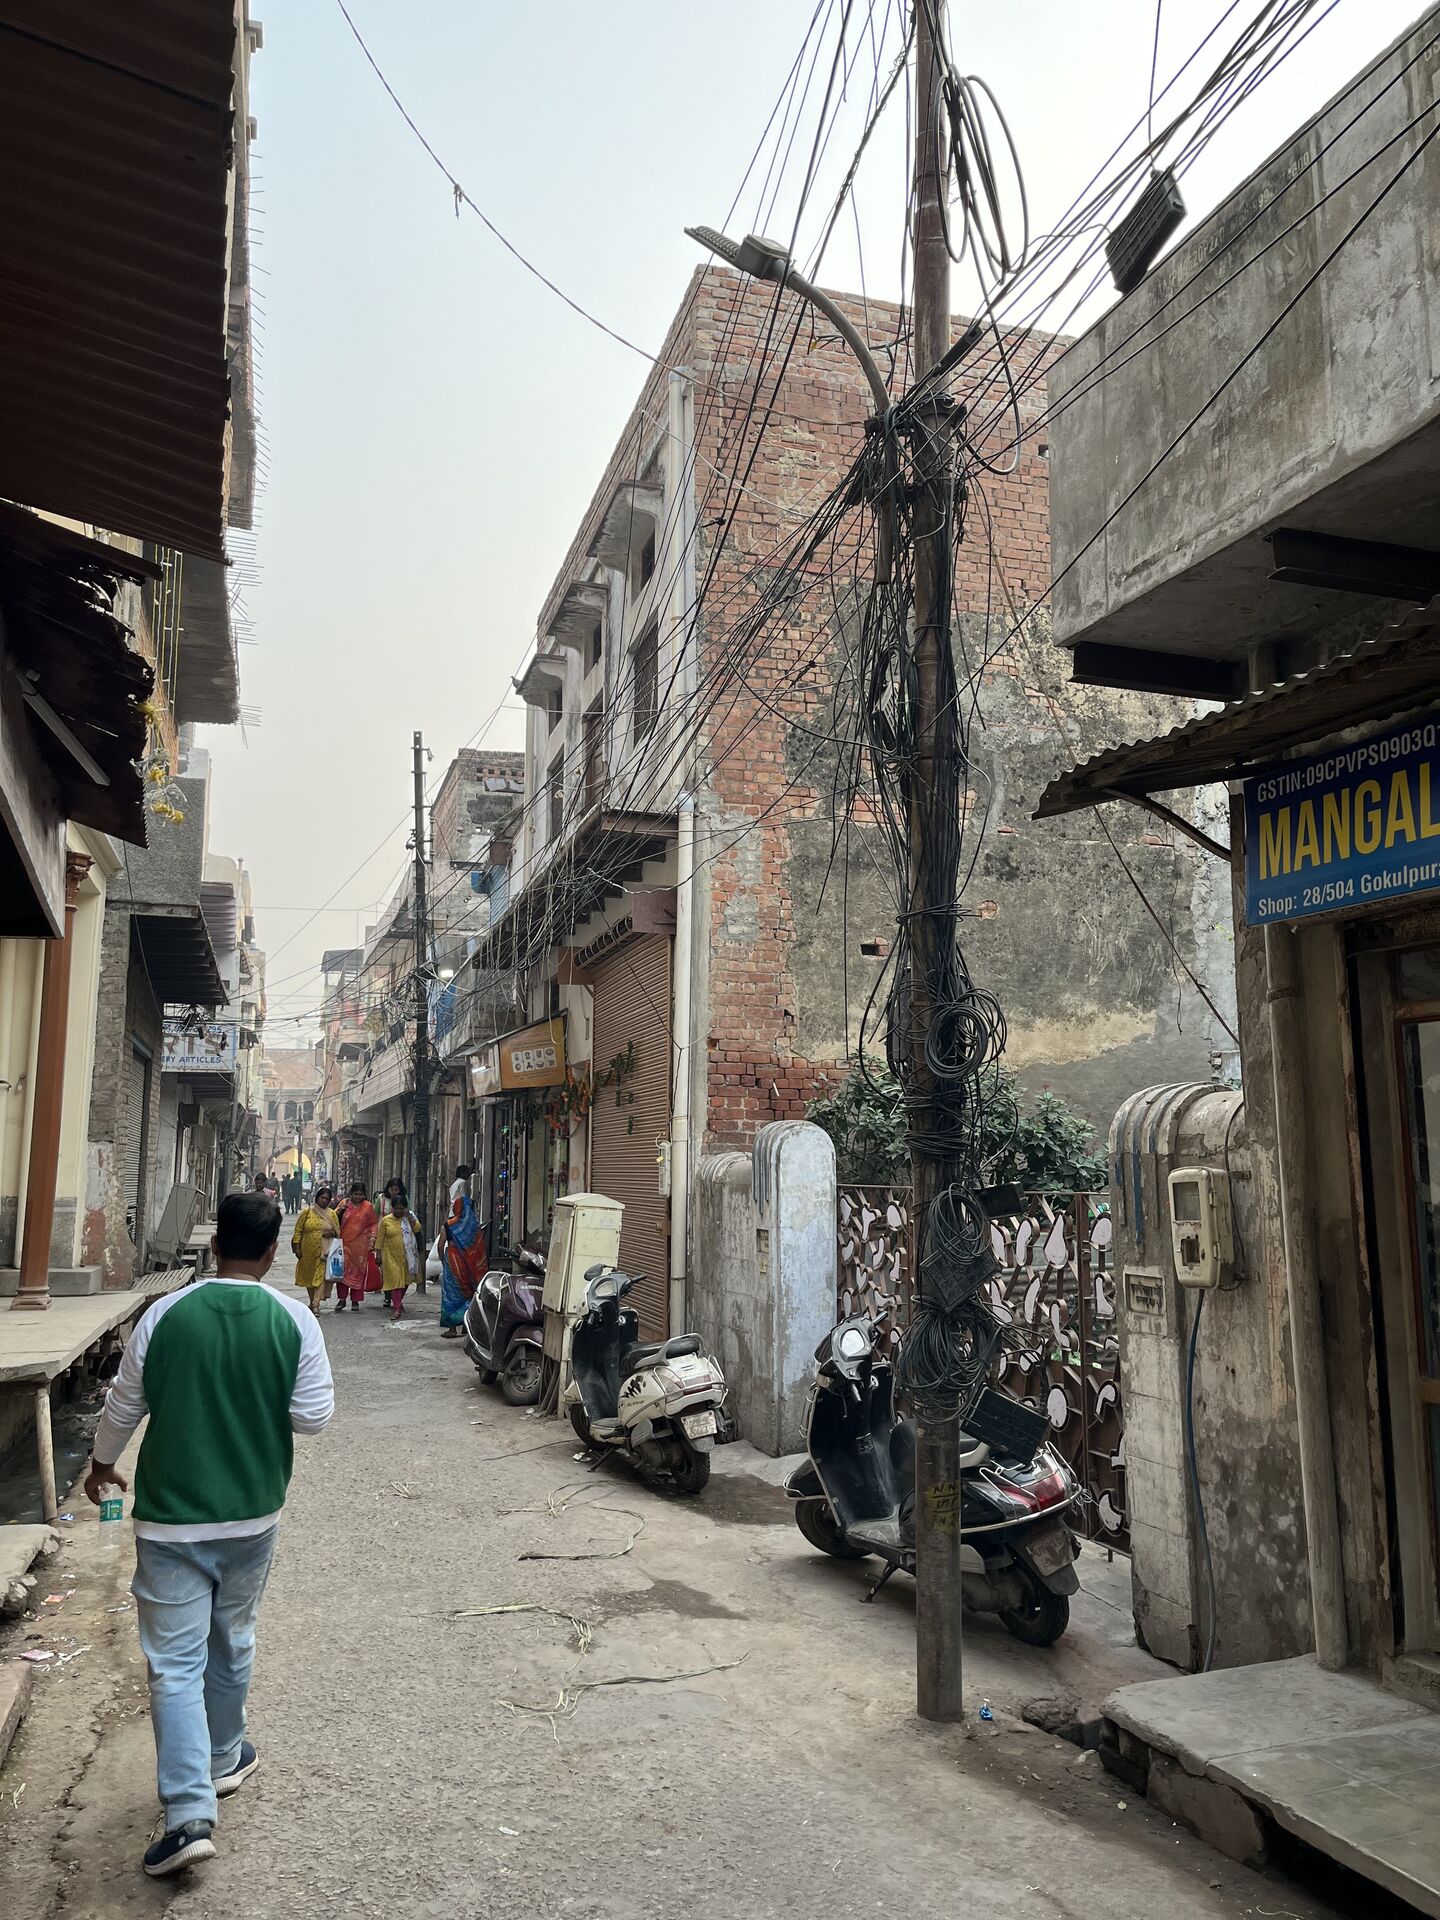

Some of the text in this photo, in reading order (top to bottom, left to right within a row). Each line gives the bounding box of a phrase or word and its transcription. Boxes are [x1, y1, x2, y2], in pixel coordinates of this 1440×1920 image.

[1257, 724, 1440, 803] GSTIN:09CPVPS0903Q
[1259, 761, 1440, 881] MANGAL
[1258, 895, 1298, 917] Shop:
[1303, 878, 1355, 907] 28/504
[179, 1055, 222, 1064] ARTICLES
